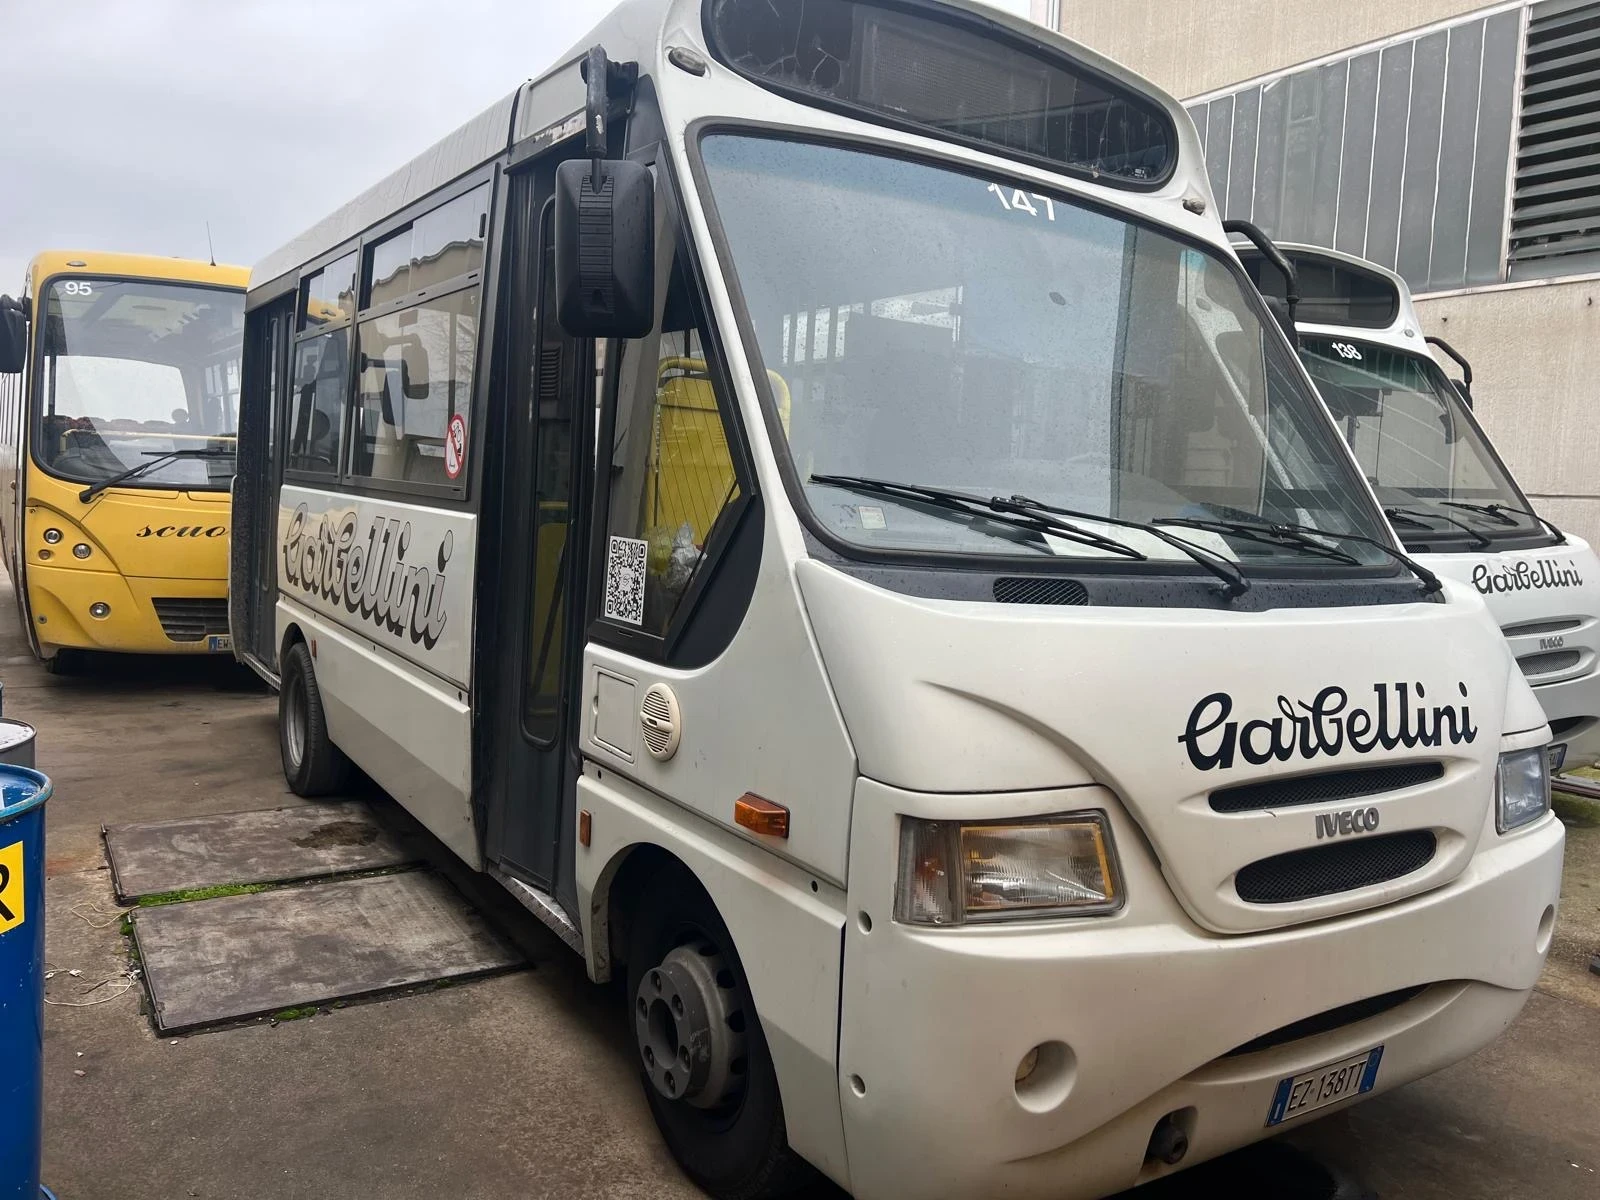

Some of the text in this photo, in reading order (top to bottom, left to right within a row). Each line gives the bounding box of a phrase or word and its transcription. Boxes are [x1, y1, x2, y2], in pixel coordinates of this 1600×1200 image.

[987, 182, 1055, 221] 147
[64, 281, 92, 296] 95
[1331, 341, 1362, 360] 138
[1471, 559, 1583, 594] Garbellini
[1178, 681, 1478, 771] Garbellini
[1315, 807, 1379, 839] IVECO
